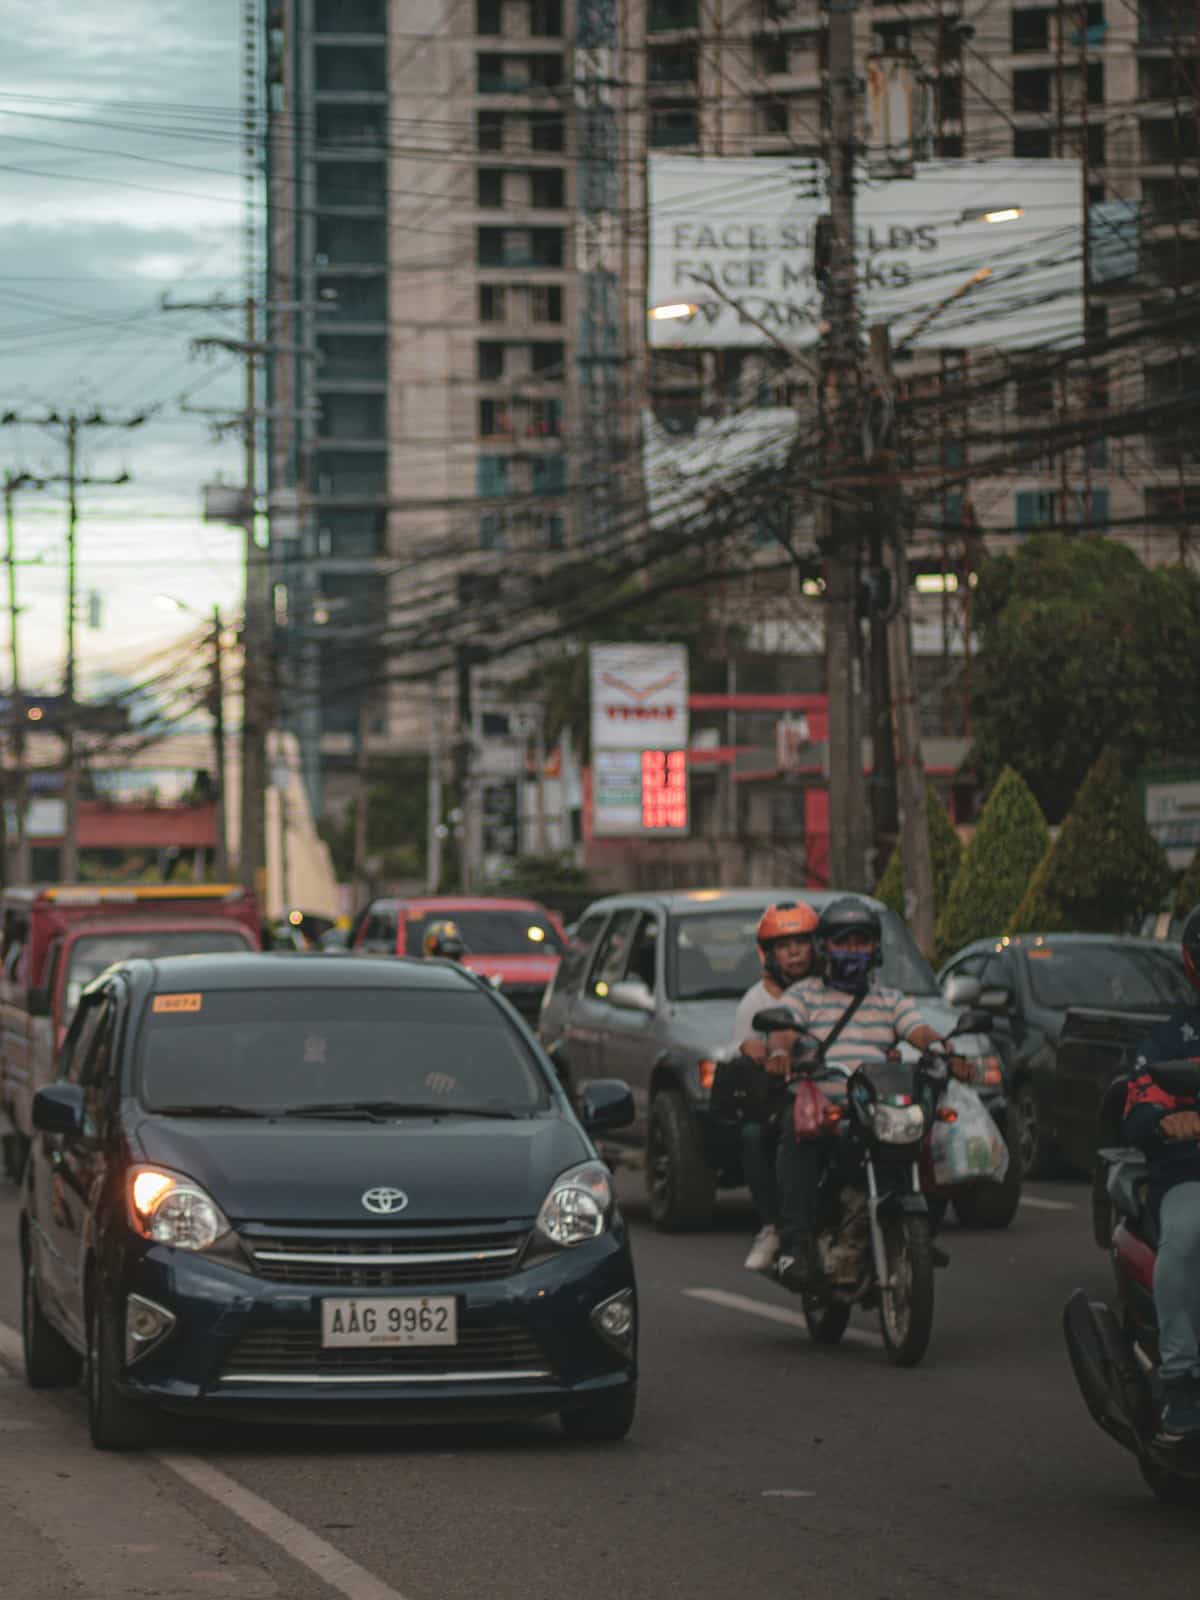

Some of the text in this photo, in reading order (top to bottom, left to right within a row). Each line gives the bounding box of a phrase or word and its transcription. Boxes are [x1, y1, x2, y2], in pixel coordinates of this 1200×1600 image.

[674, 223, 766, 249] FACE
[674, 260, 766, 288] FACE
[388, 1306, 448, 1332] 9962
